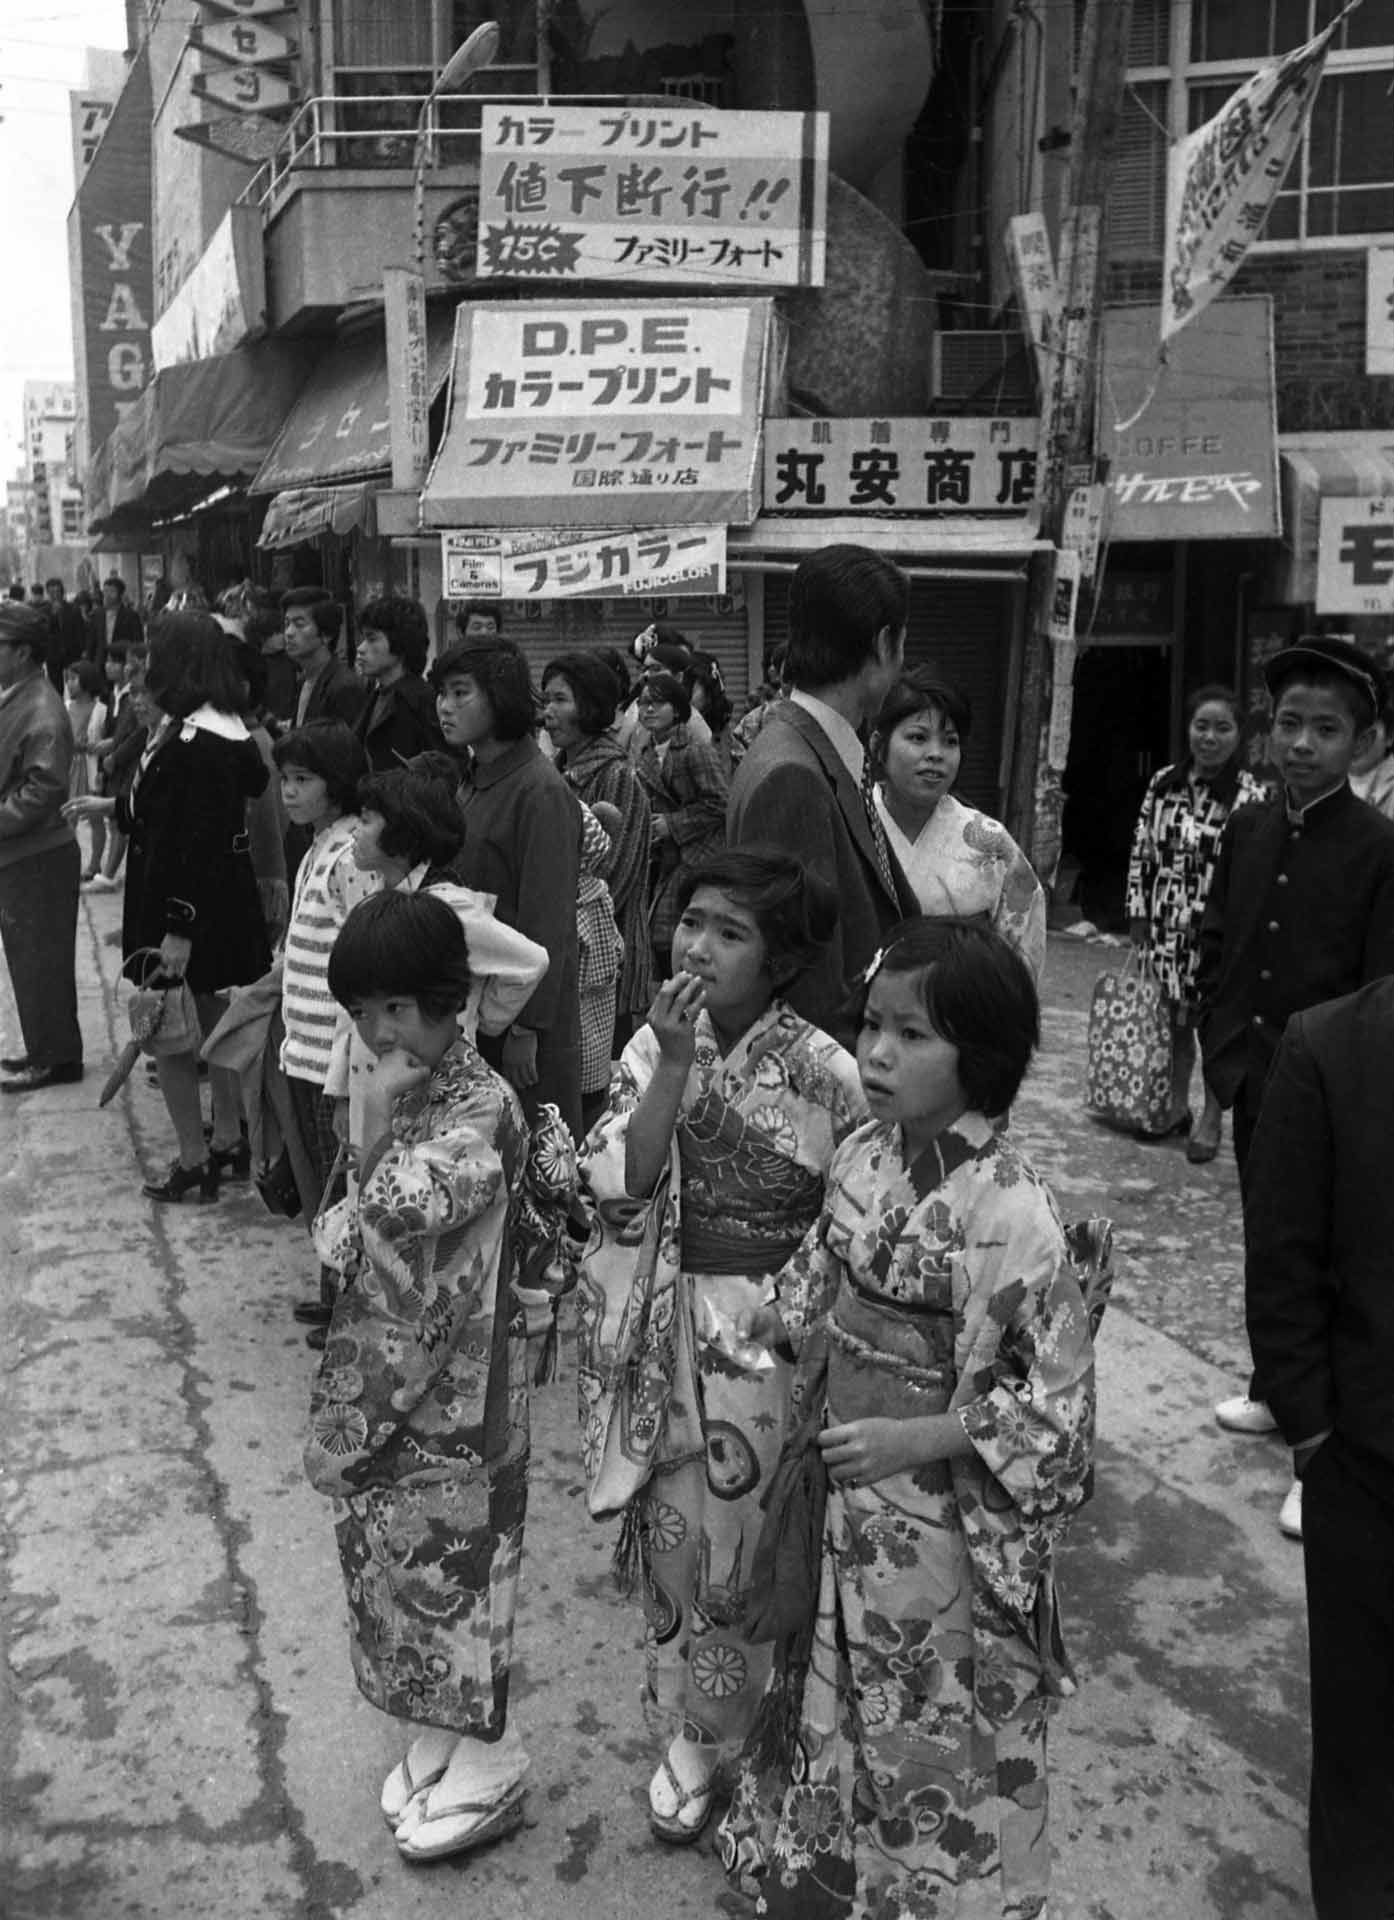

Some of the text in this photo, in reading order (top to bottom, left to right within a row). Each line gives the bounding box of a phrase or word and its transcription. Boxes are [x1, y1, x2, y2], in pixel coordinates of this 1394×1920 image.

[614, 235, 784, 268] ファミリーフォート
[483, 366, 732, 409] カラープリント
[467, 430, 743, 467] ファミリーフォート
[776, 448, 1038, 505] 丸安商店
[461, 559, 485, 569] Film
[513, 535, 708, 593] フジカラー
[622, 566, 713, 595] FUJICOLOR
[451, 579, 499, 590] Cameras
